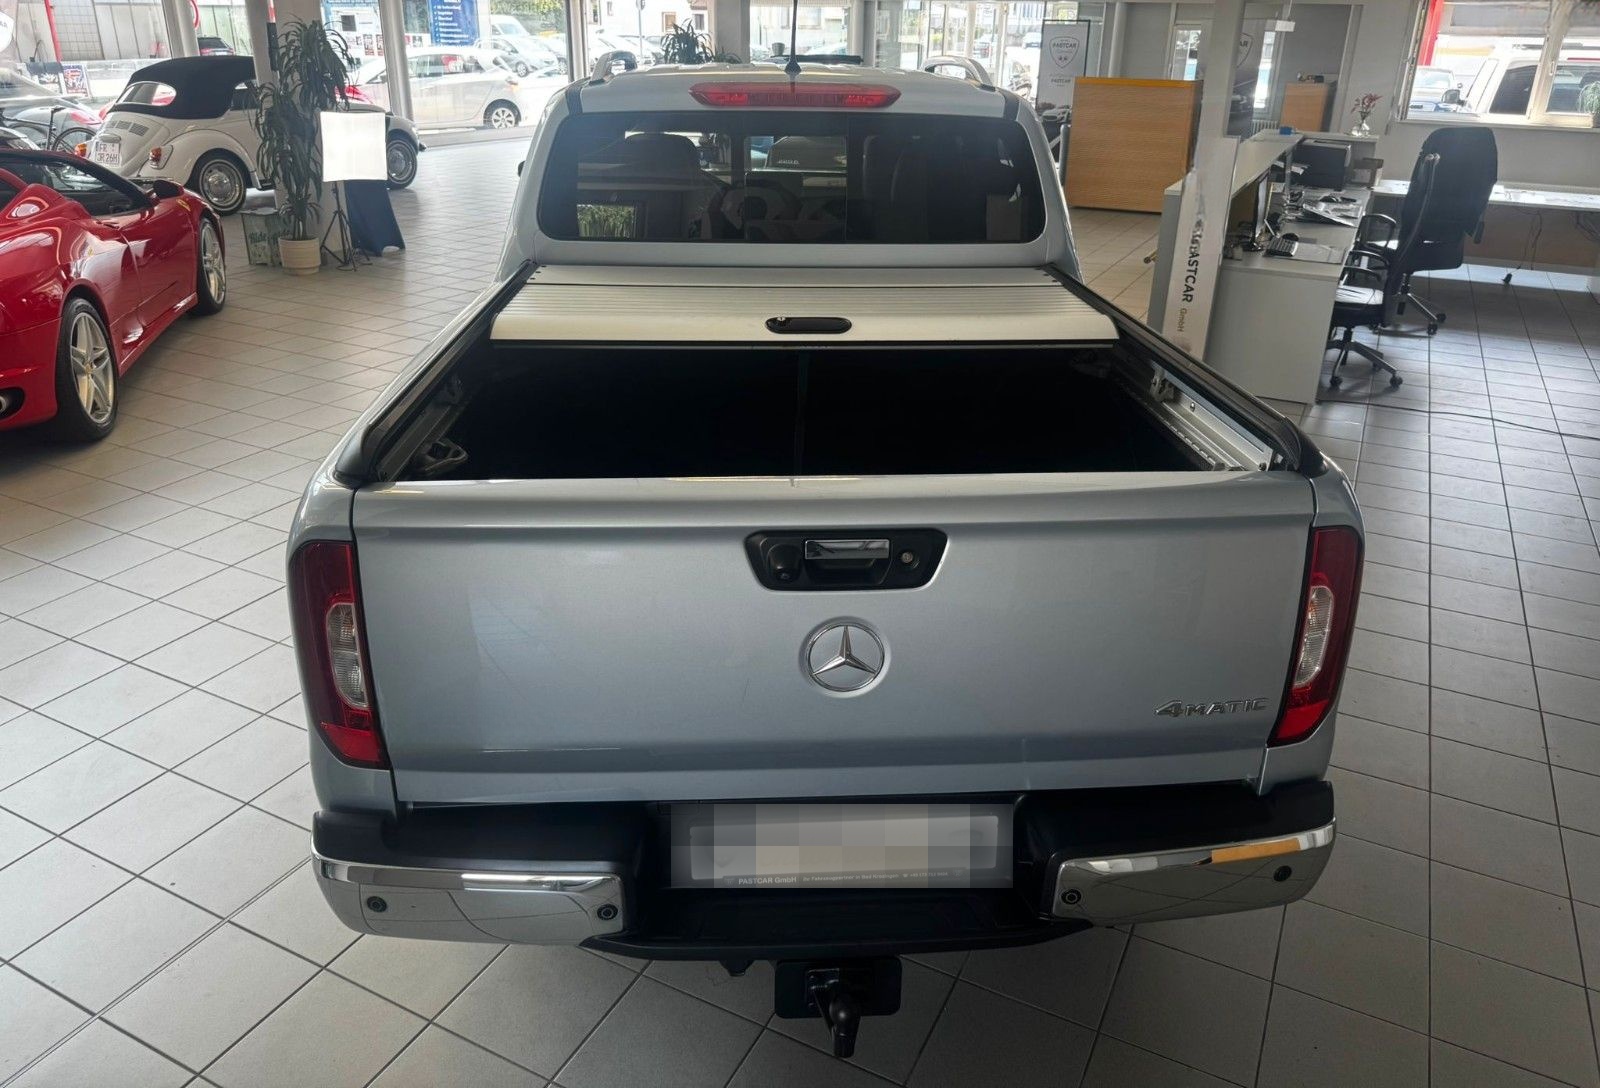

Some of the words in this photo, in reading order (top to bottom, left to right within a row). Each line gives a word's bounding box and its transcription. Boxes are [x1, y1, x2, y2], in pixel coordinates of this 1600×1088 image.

[1177, 307, 1188, 333] GmbH
[1154, 697, 1269, 718] 4MATIC
[738, 877, 773, 885] PASTCAR
[774, 876, 797, 884] GmbH
